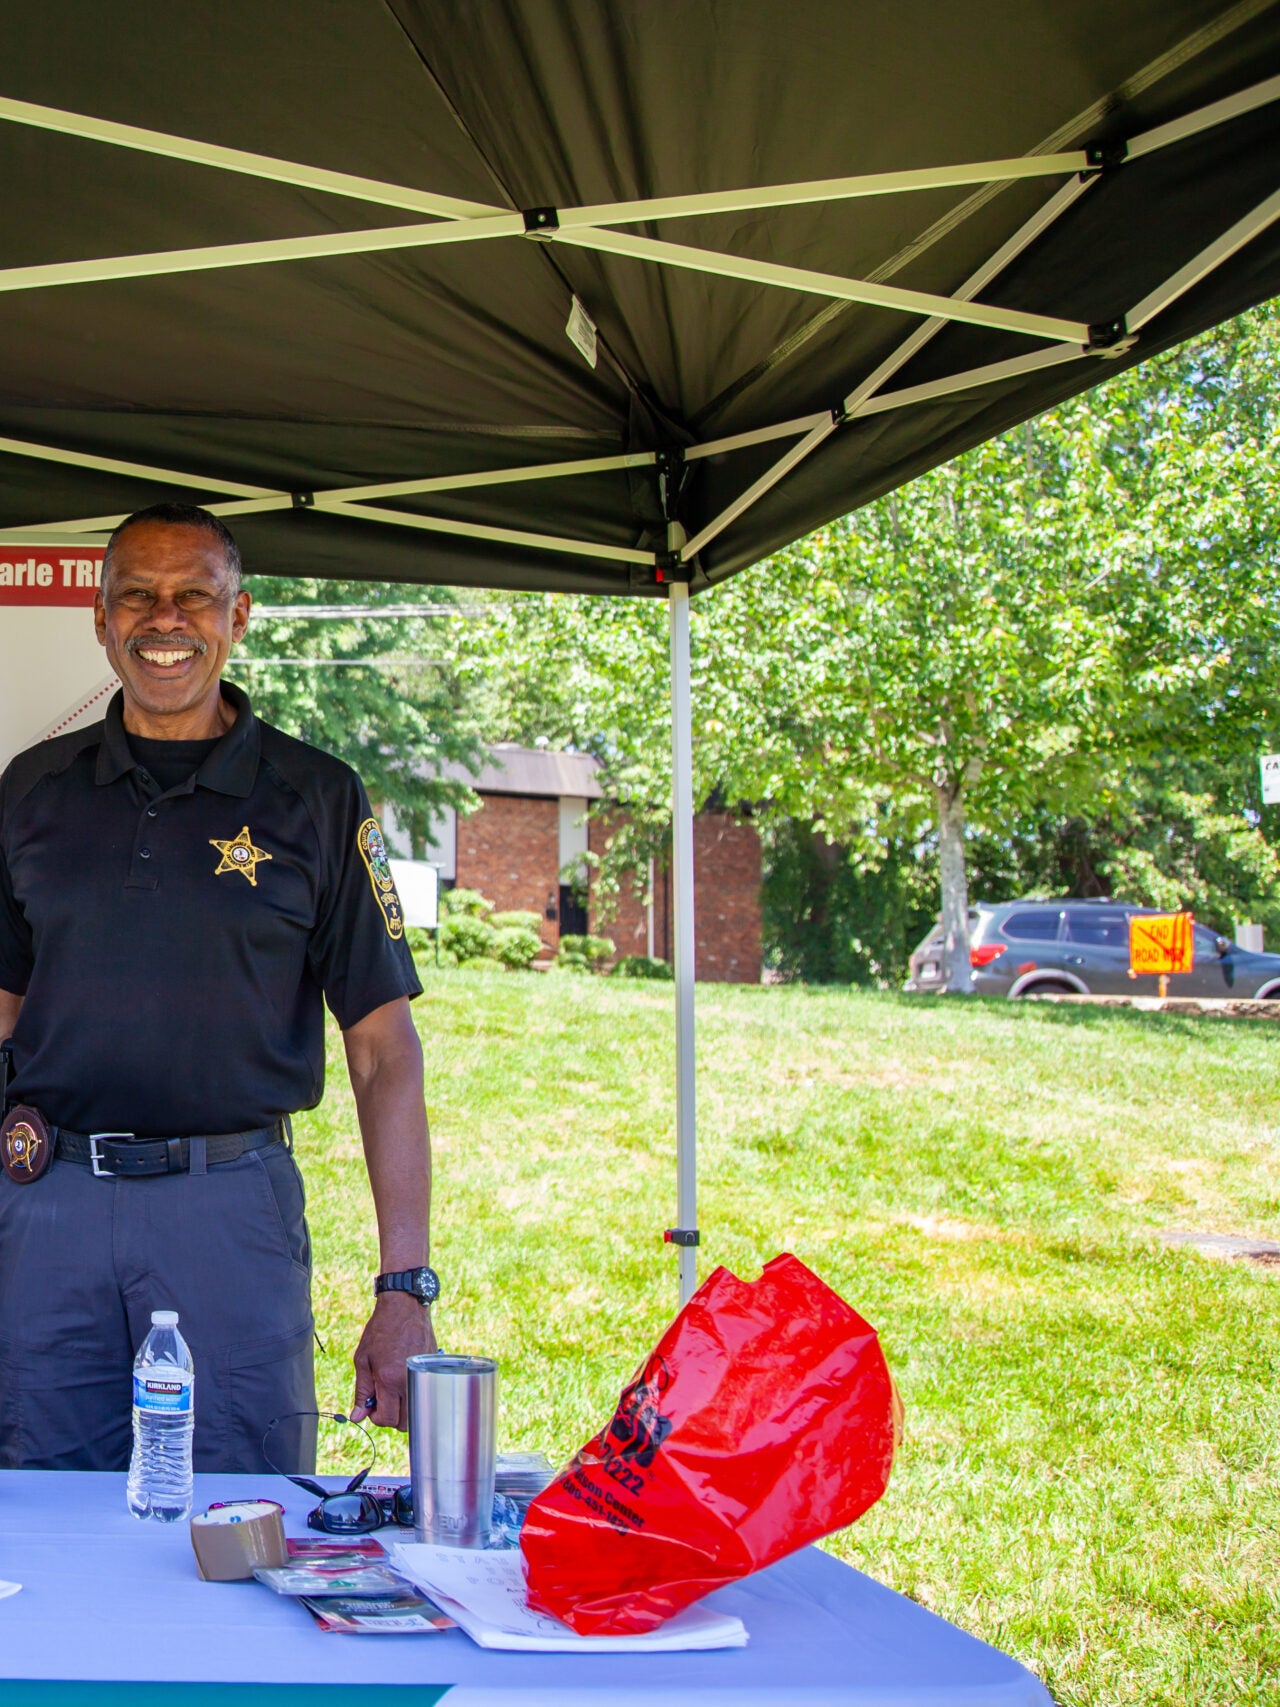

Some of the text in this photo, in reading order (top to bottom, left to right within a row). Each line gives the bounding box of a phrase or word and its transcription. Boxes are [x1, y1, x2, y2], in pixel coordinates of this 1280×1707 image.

[1150, 924, 1169, 940] END
[1135, 948, 1160, 963] ROAD
[146, 1382, 182, 1391] KIRKLAND
